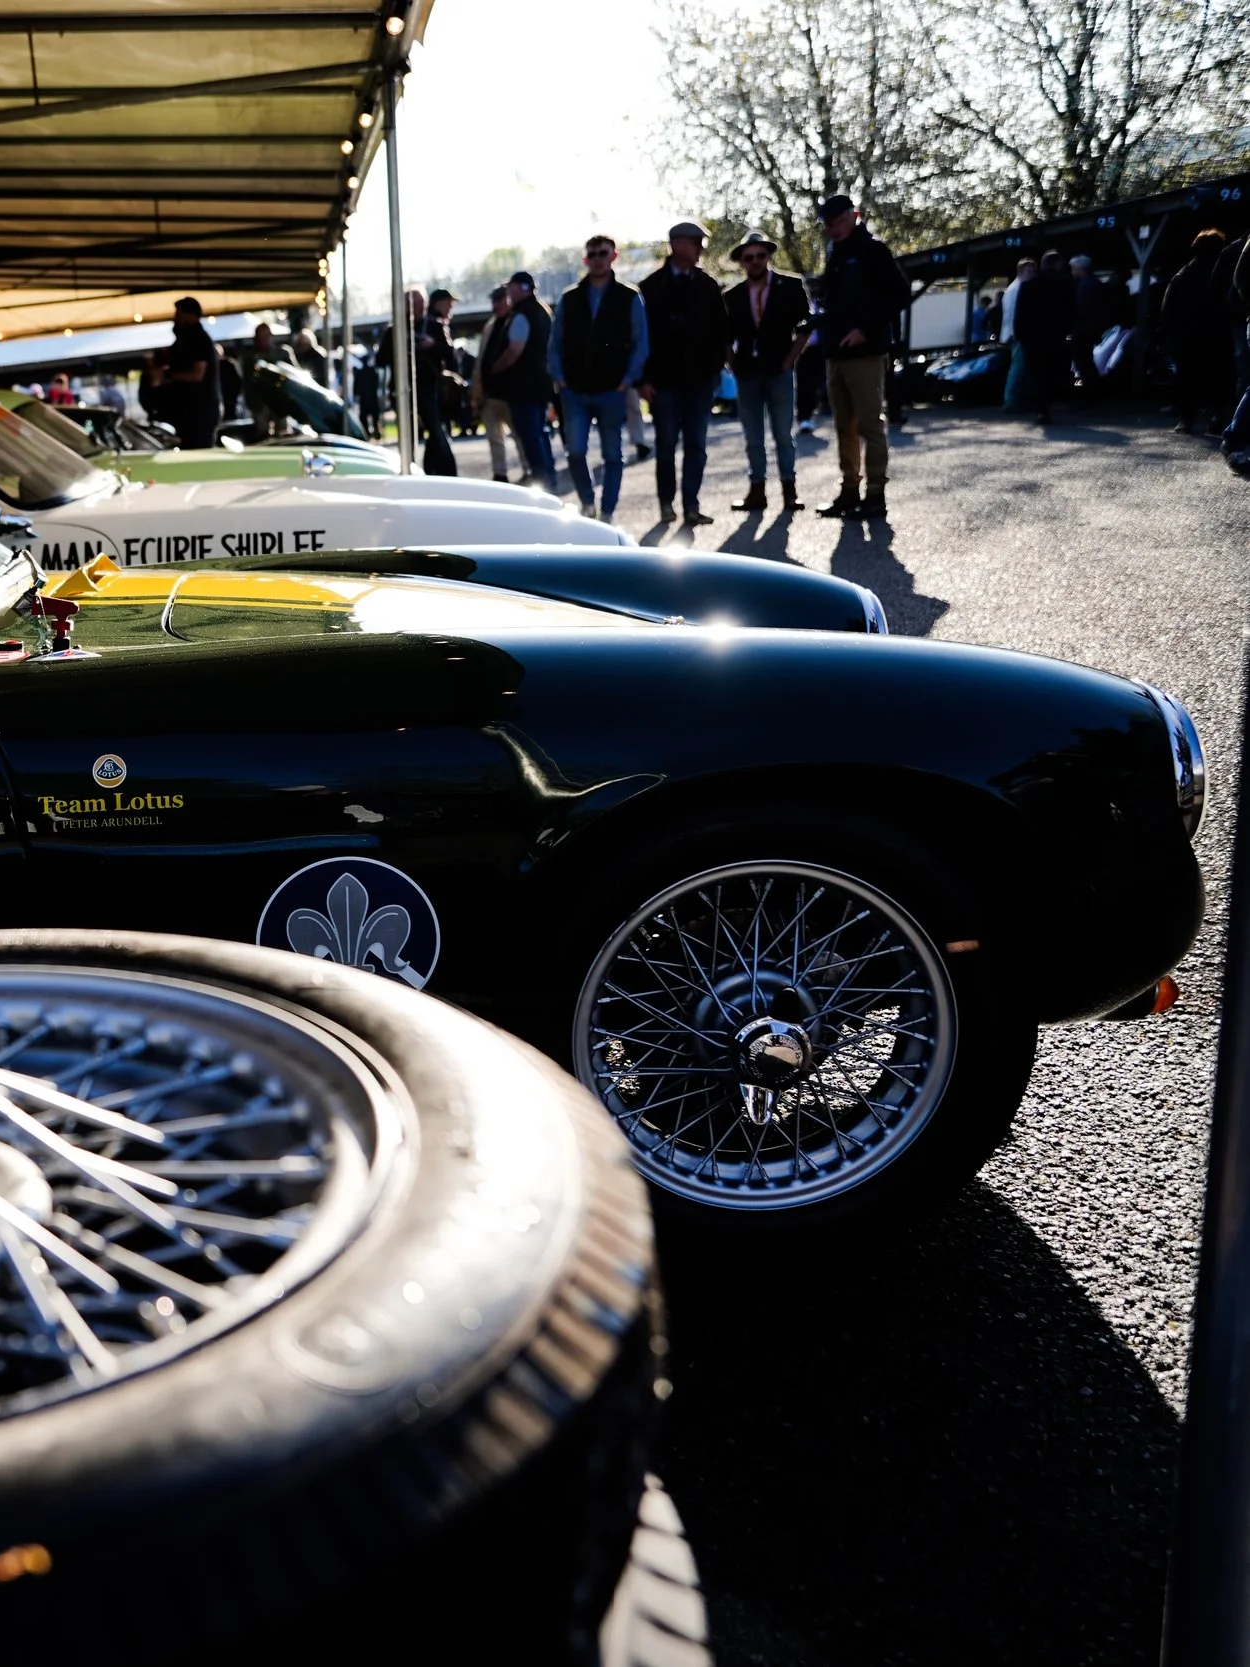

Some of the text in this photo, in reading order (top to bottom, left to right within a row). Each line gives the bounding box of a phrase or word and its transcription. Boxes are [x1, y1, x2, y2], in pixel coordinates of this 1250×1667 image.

[98, 769, 122, 777] LOTUS
[37, 792, 184, 815] Team Lotus
[62, 816, 163, 829] PETER ARUNDELL
